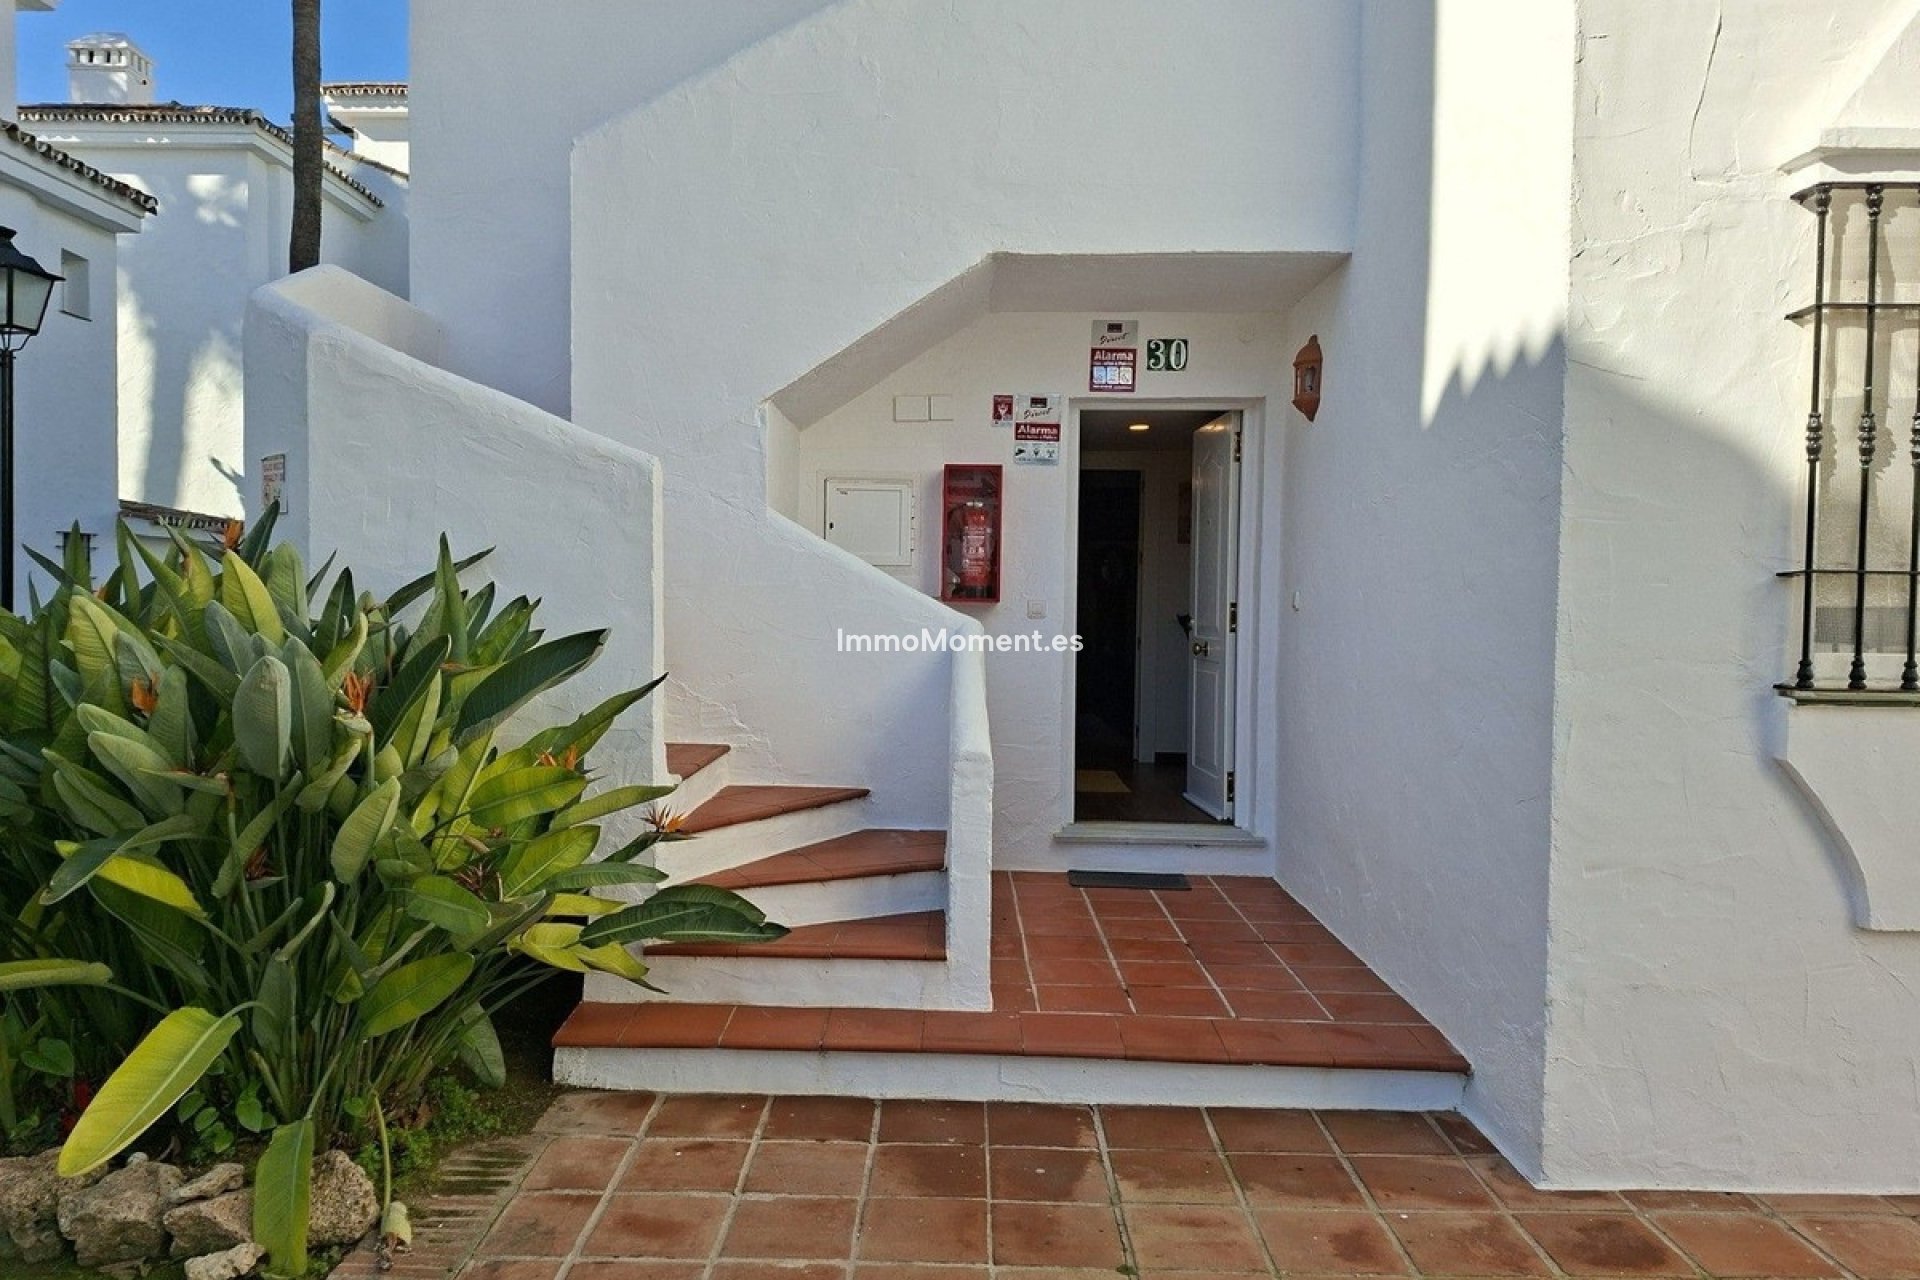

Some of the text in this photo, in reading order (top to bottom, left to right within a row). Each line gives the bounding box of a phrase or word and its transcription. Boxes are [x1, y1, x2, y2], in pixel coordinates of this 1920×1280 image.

[1093, 349, 1134, 361] Alarma
[1149, 340, 1187, 370] 30
[1017, 425, 1058, 435] Alarma
